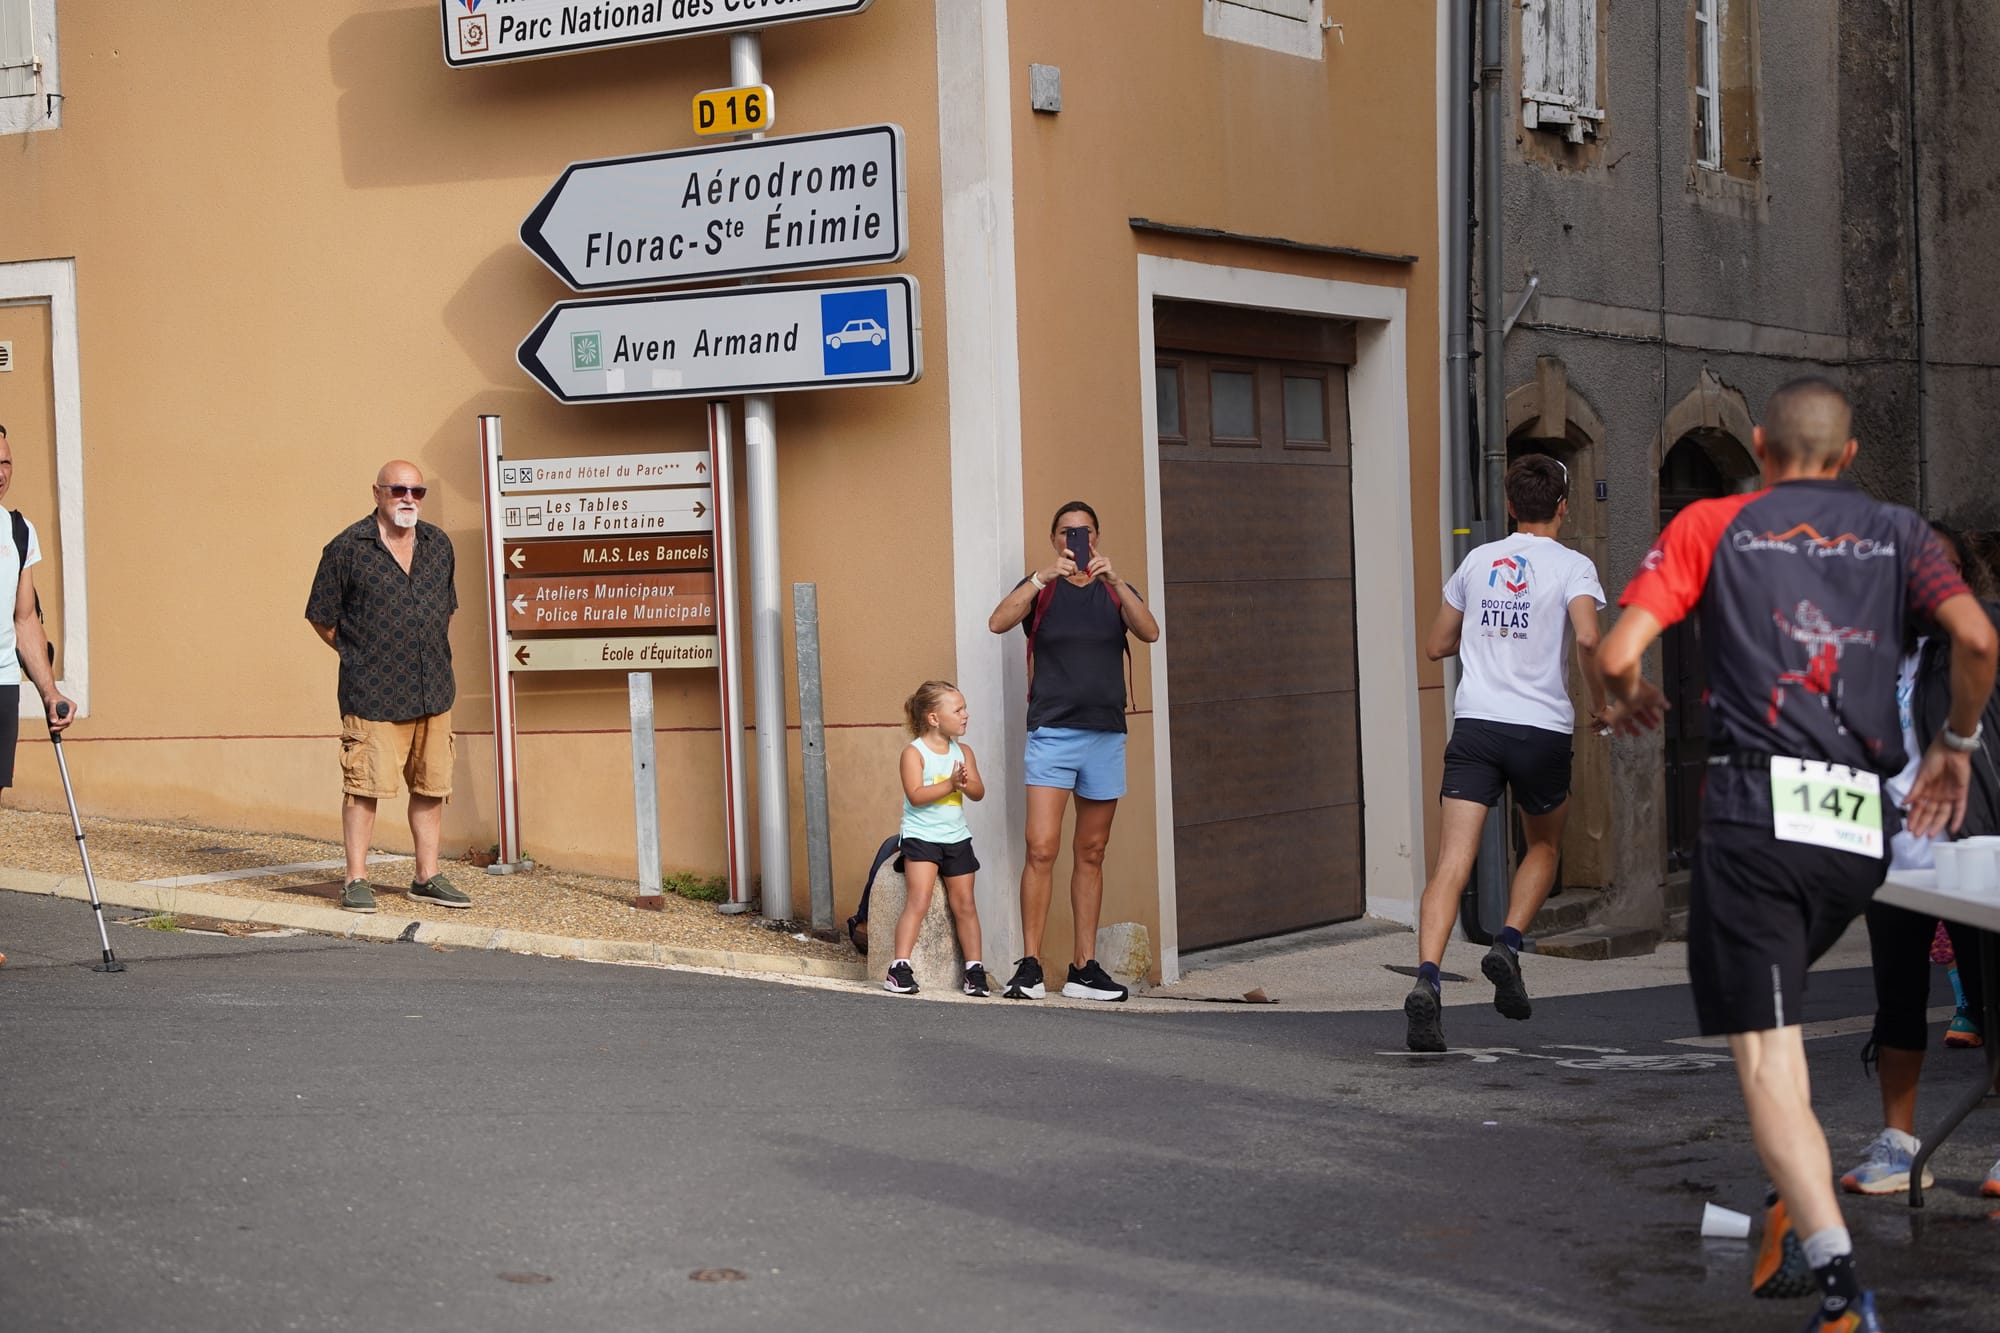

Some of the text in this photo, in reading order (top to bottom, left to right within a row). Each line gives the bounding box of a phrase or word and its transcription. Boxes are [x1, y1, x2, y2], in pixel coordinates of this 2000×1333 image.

[499, 15, 552, 44] Parc
[560, 2, 662, 35] National
[699, 93, 762, 128] D 16
[681, 160, 878, 208] Aérodrome
[765, 204, 881, 249] Énimie
[613, 323, 799, 363] Aven Armand
[536, 467, 572, 481] Grand
[578, 465, 610, 479] Hôtel
[616, 465, 630, 477] du
[546, 497, 629, 513] Les Tables
[547, 515, 665, 531] de la Fontaine
[583, 544, 709, 563] M.A.S. Les Bancels
[536, 582, 675, 601] Ateliers Municipaux
[536, 602, 711, 622] Police Rurale Municipale
[1481, 600, 1531, 610] BOOTCAMP
[1481, 610, 1529, 629] ATLAS
[602, 643, 634, 661] École
[1793, 784, 1866, 821] 147
